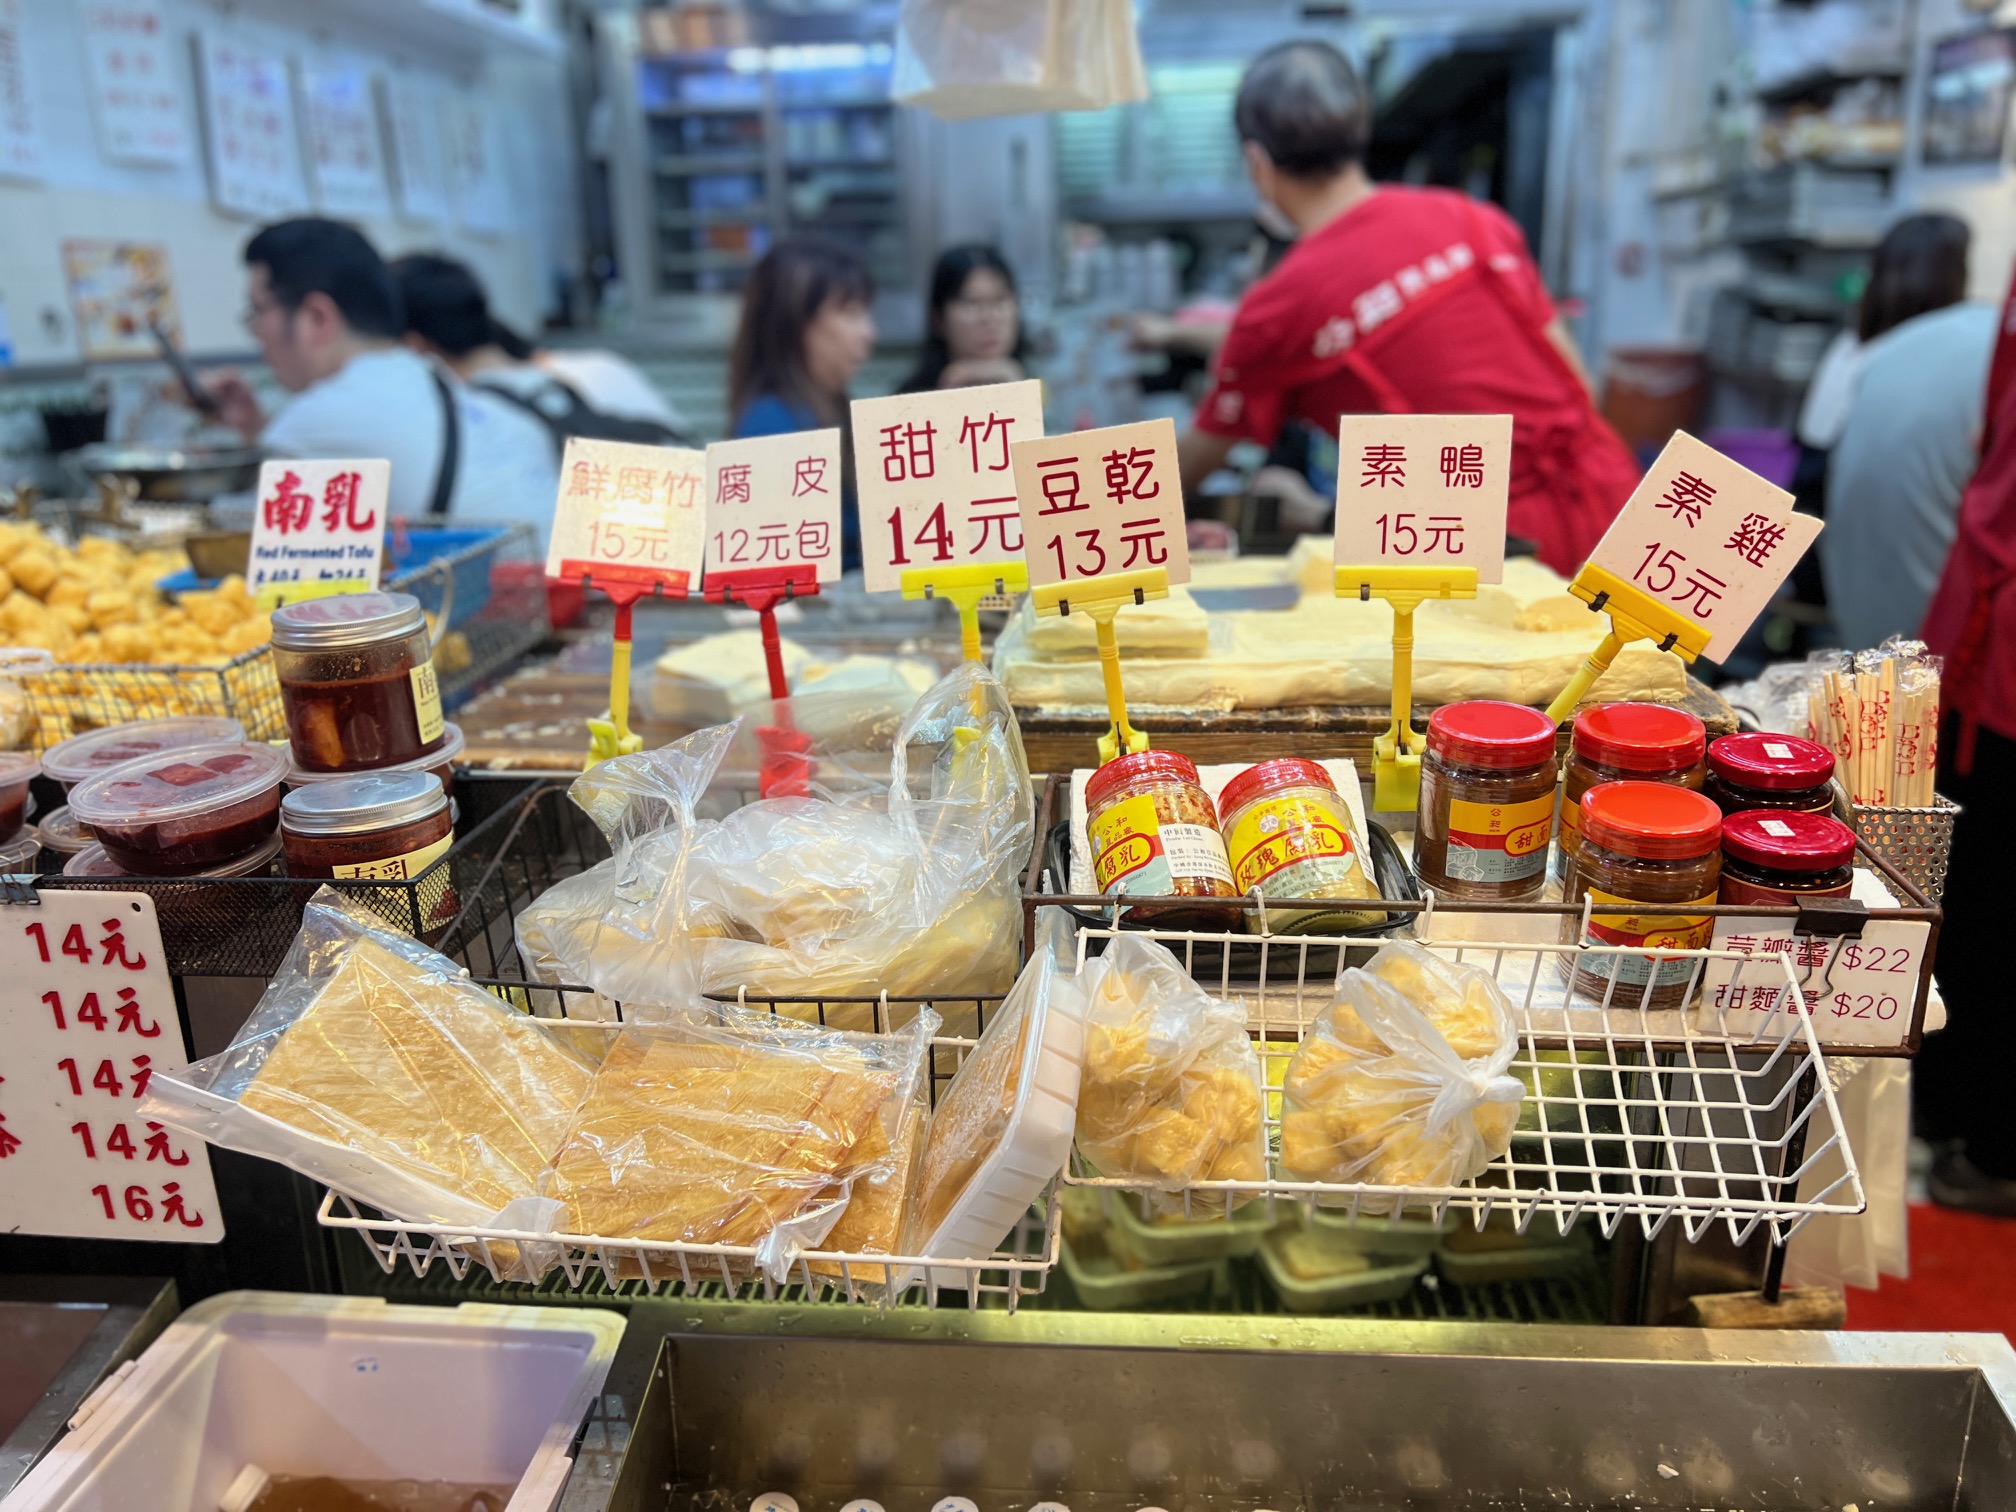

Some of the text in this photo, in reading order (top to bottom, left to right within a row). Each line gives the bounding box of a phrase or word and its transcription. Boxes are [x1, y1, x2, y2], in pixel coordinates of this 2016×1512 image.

[879, 412, 1016, 482] 甜竹
[1361, 443, 1485, 488] 素鴨
[264, 469, 376, 536] 南乳
[567, 461, 702, 508] 鮮腐竹
[716, 455, 828, 504] 腐皮
[1036, 446, 1160, 516] 豆乾
[588, 521, 669, 562] 15元
[714, 519, 830, 563] 12元包
[887, 501, 1025, 566] 14元
[1376, 513, 1465, 555] 15元
[1655, 470, 1786, 568] 素雞
[256, 545, 375, 559] Red Fermented Tofu
[1047, 518, 1168, 580] 13元
[1633, 542, 1727, 618] 15元
[1103, 816, 1128, 836] 公和
[1283, 804, 1316, 817] 公和
[1490, 808, 1502, 828] 公和
[1240, 831, 1335, 888] 玫瑰腐乳
[25, 918, 147, 970] 14元
[1842, 944, 1911, 974] $22
[42, 987, 160, 1038] 14元
[1831, 992, 1899, 1020] $20
[72, 1121, 190, 1166] 14元
[92, 1182, 203, 1228] 16元
